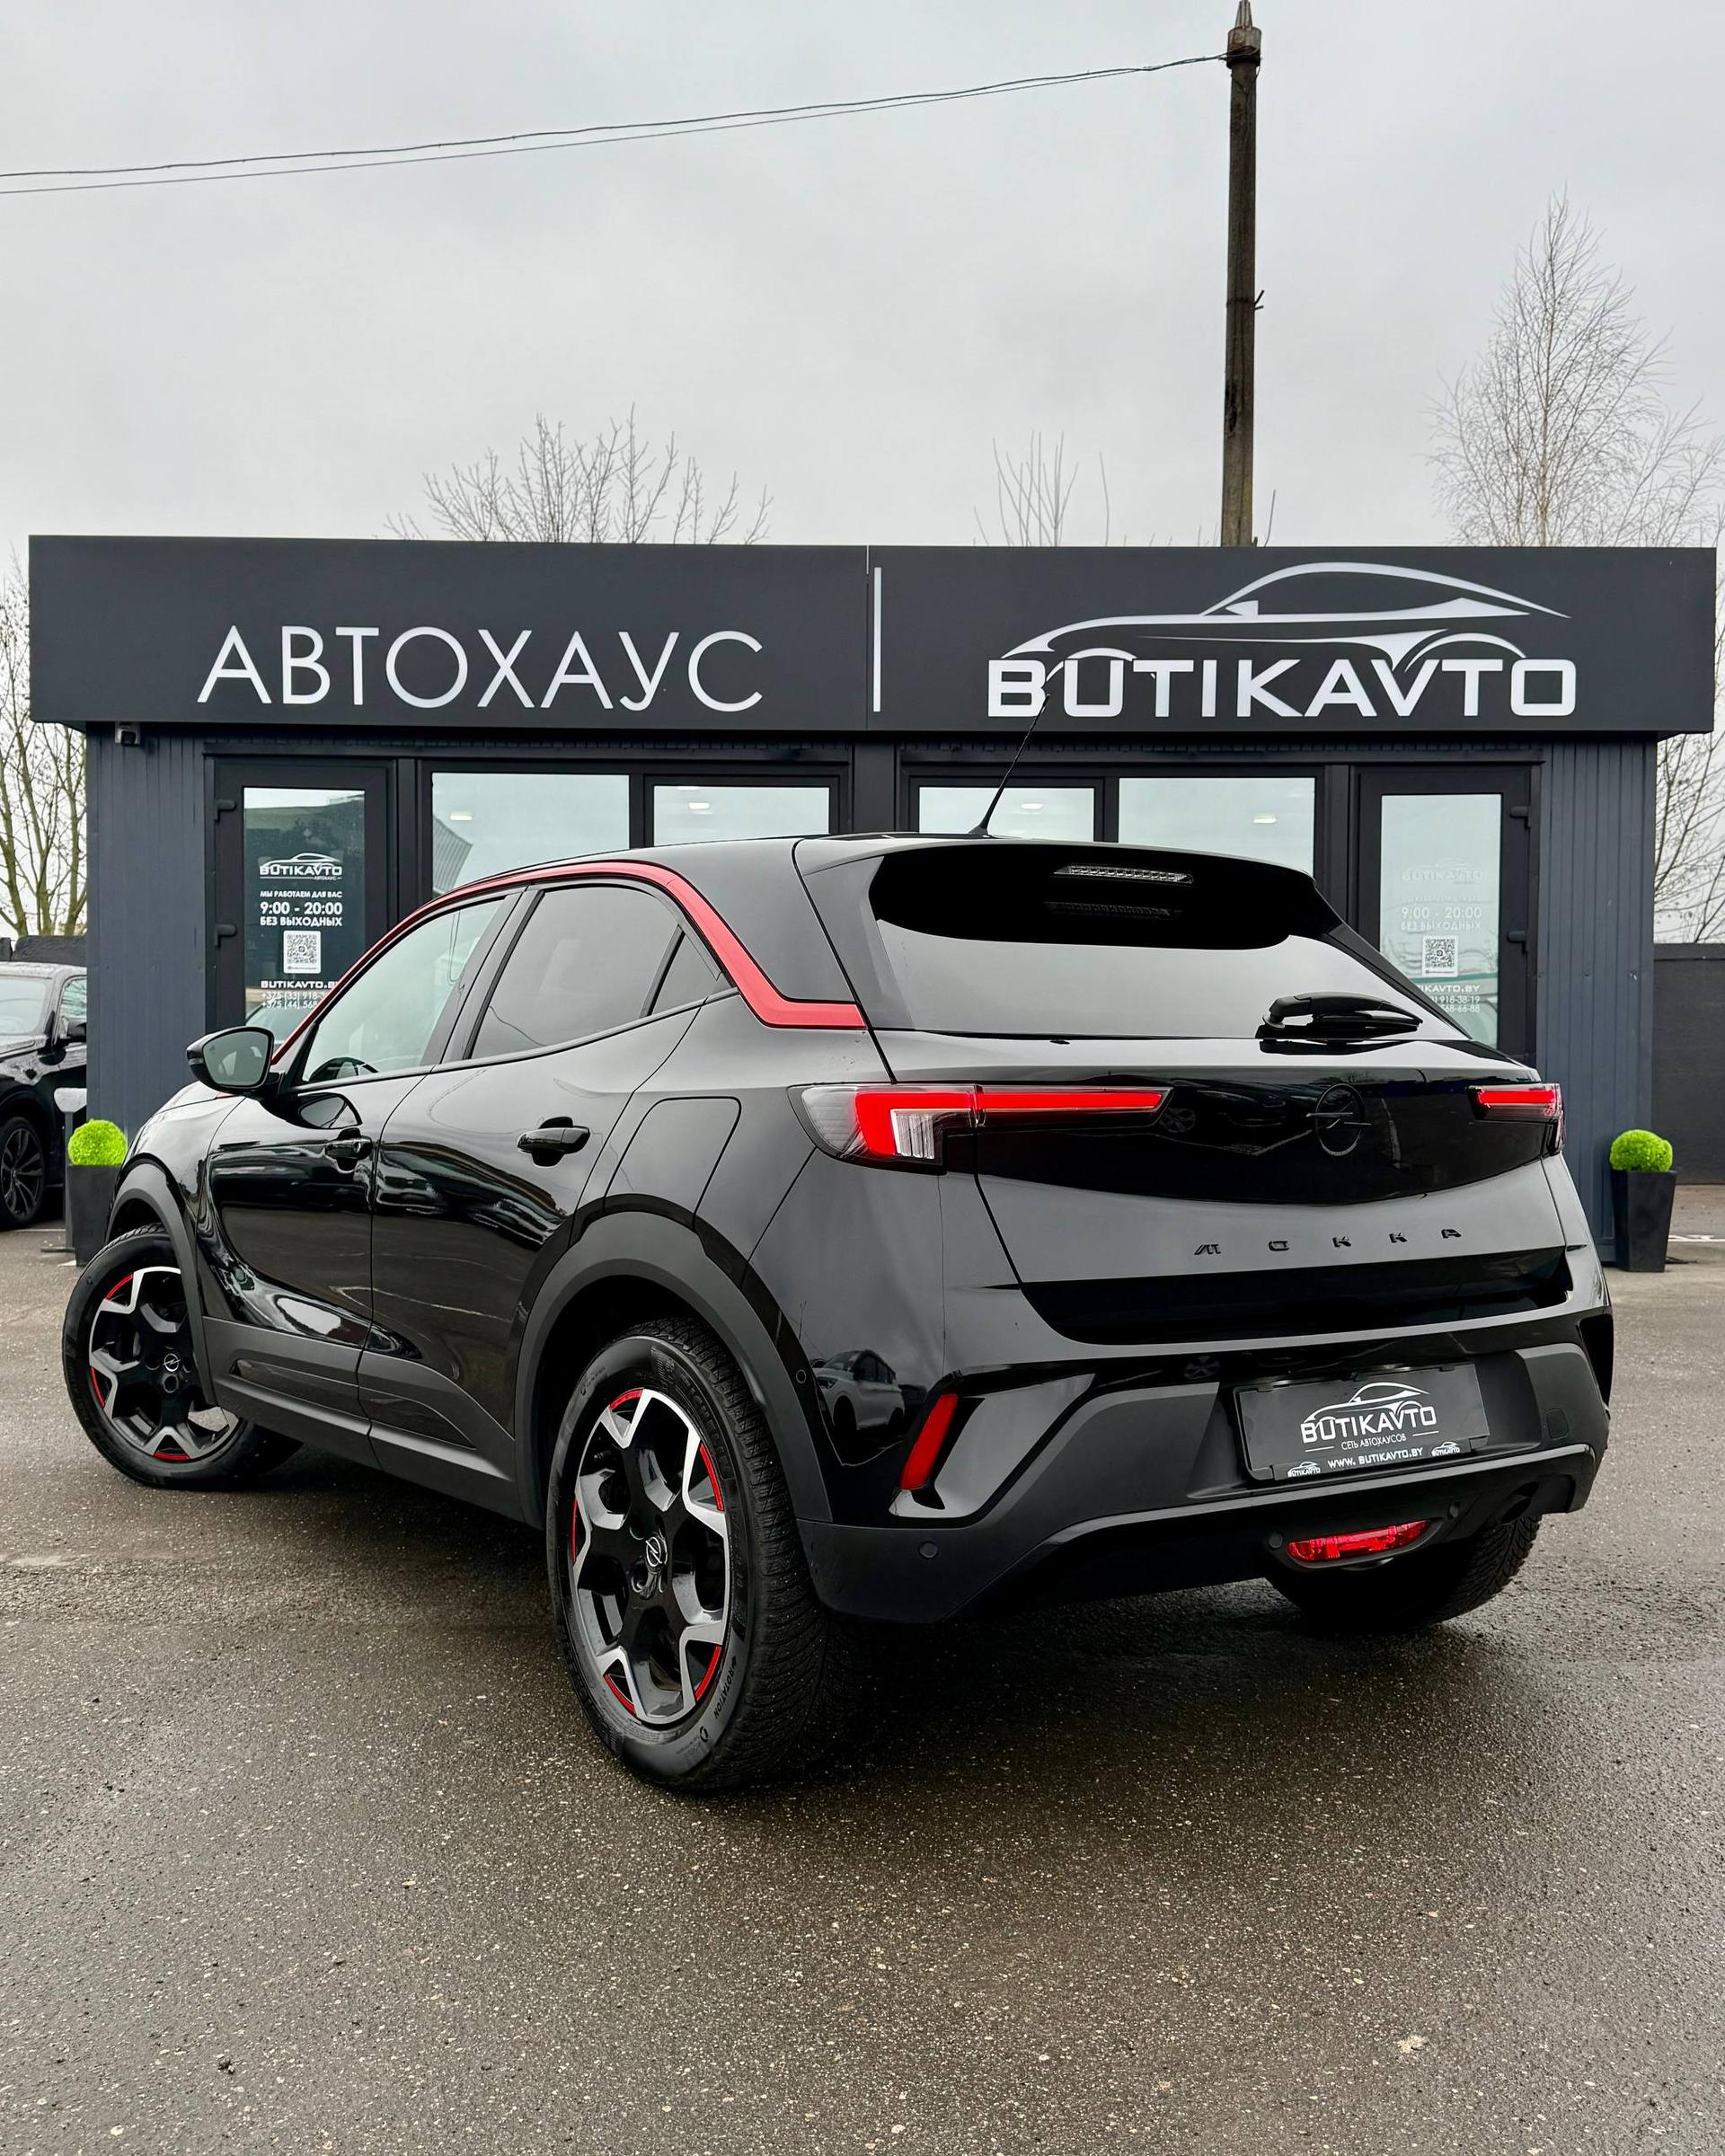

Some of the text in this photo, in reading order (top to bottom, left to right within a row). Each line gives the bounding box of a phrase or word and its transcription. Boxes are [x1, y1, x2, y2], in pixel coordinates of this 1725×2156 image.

[197, 624, 763, 712] АВТОХАУС
[987, 658, 1576, 718] BUTIKAVTO
[260, 865, 342, 876] BUTIKAVTO
[260, 901, 290, 915] 9:00
[304, 901, 343, 915] 20:00
[1401, 906, 1429, 919] 9:00
[1444, 906, 1482, 919] 20:00
[260, 916, 342, 927] БЕЗ ВЫХОДНЫХ
[261, 980, 338, 989] BUTIKAVTO.B
[1439, 995, 1481, 1004] 918-38-19
[1194, 1227, 1463, 1256] MOKKA
[1300, 1406, 1438, 1444] BUTIKAVTO
[1340, 1433, 1407, 1451] СЕТЬ АВТОХАУСОВ
[1327, 1447, 1424, 1469] WWW. BUTIKAVTO.BY
[1431, 1445, 1461, 1457] BUTIKAVTO
[1287, 1466, 1321, 1478] BUTIKAVTO
[713, 1668, 735, 1719] ROTATION
